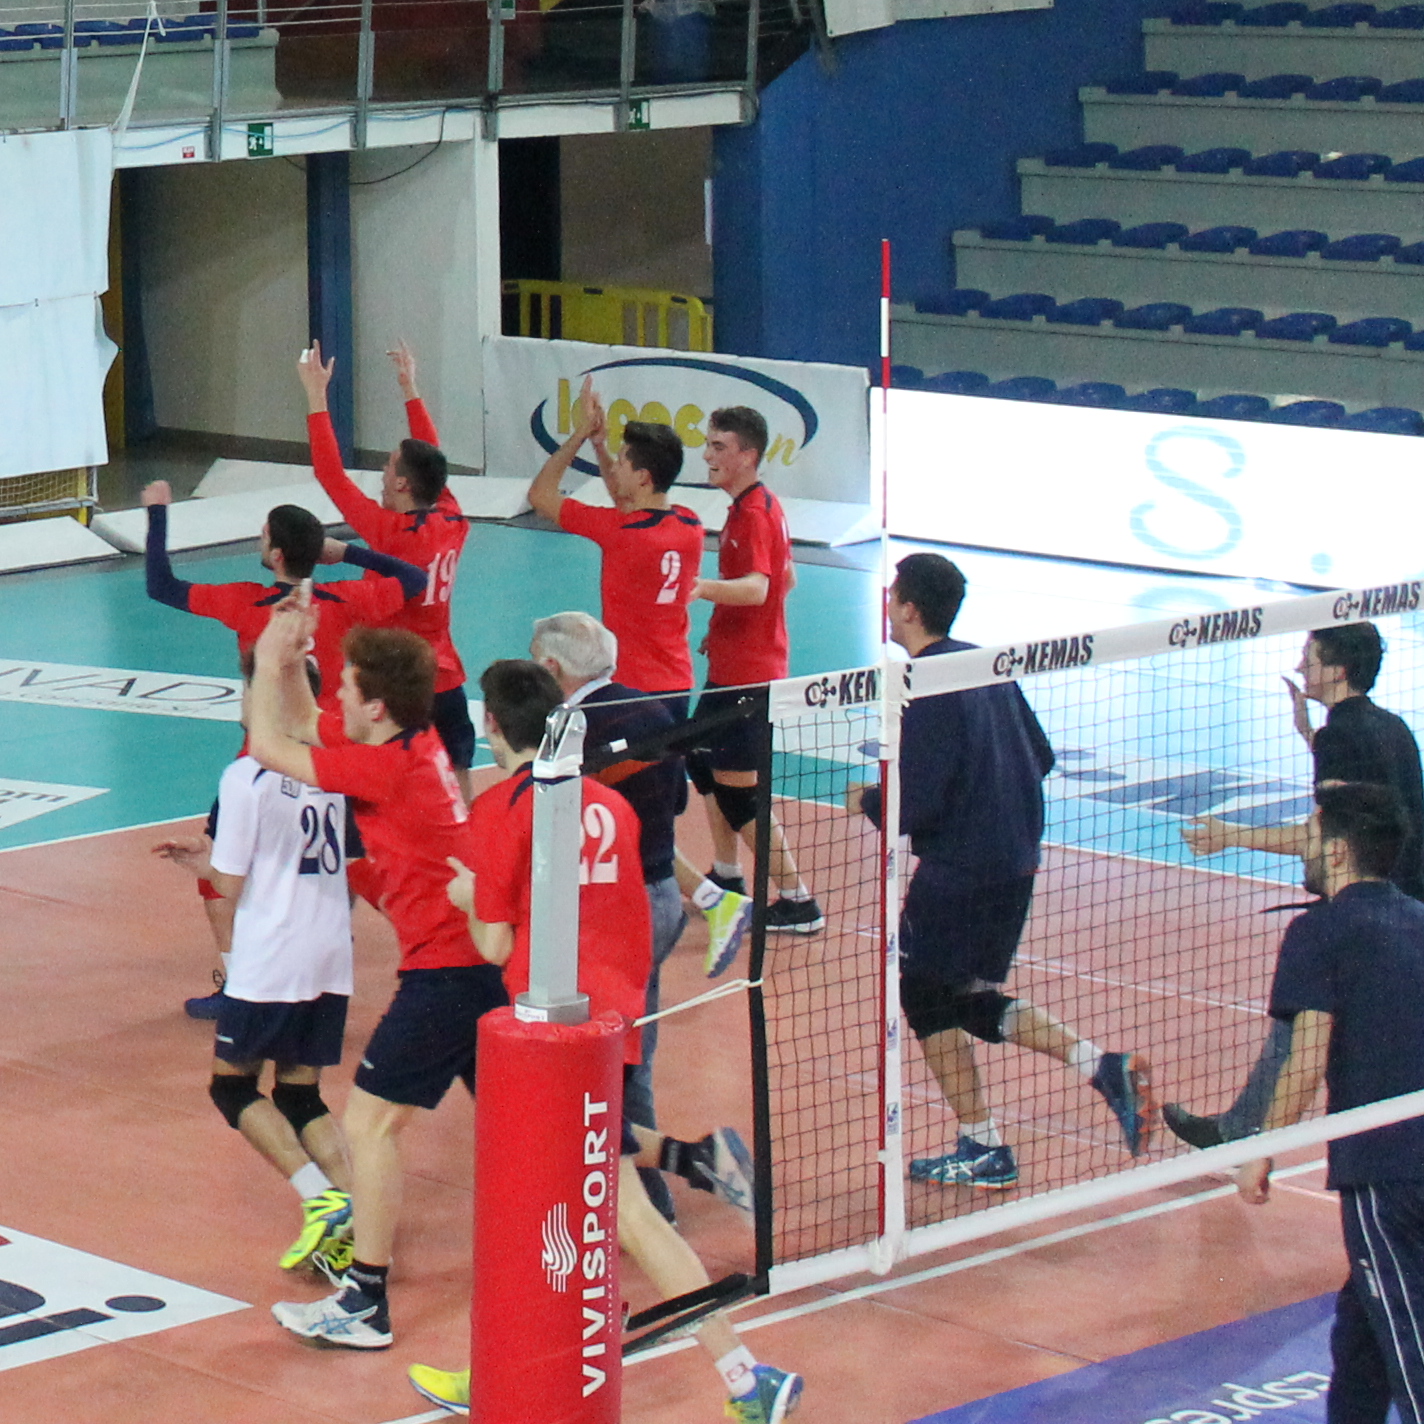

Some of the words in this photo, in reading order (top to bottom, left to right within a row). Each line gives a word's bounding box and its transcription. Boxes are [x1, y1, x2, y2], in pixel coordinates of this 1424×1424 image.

[421, 548, 458, 607] 19
[654, 550, 682, 605] 2
[1358, 579, 1422, 617] KEMAS
[1023, 634, 1095, 672] KEMAS
[1194, 607, 1264, 646] KEMAS
[297, 801, 342, 875] 28
[581, 1091, 609, 1398] VIVISPORT
